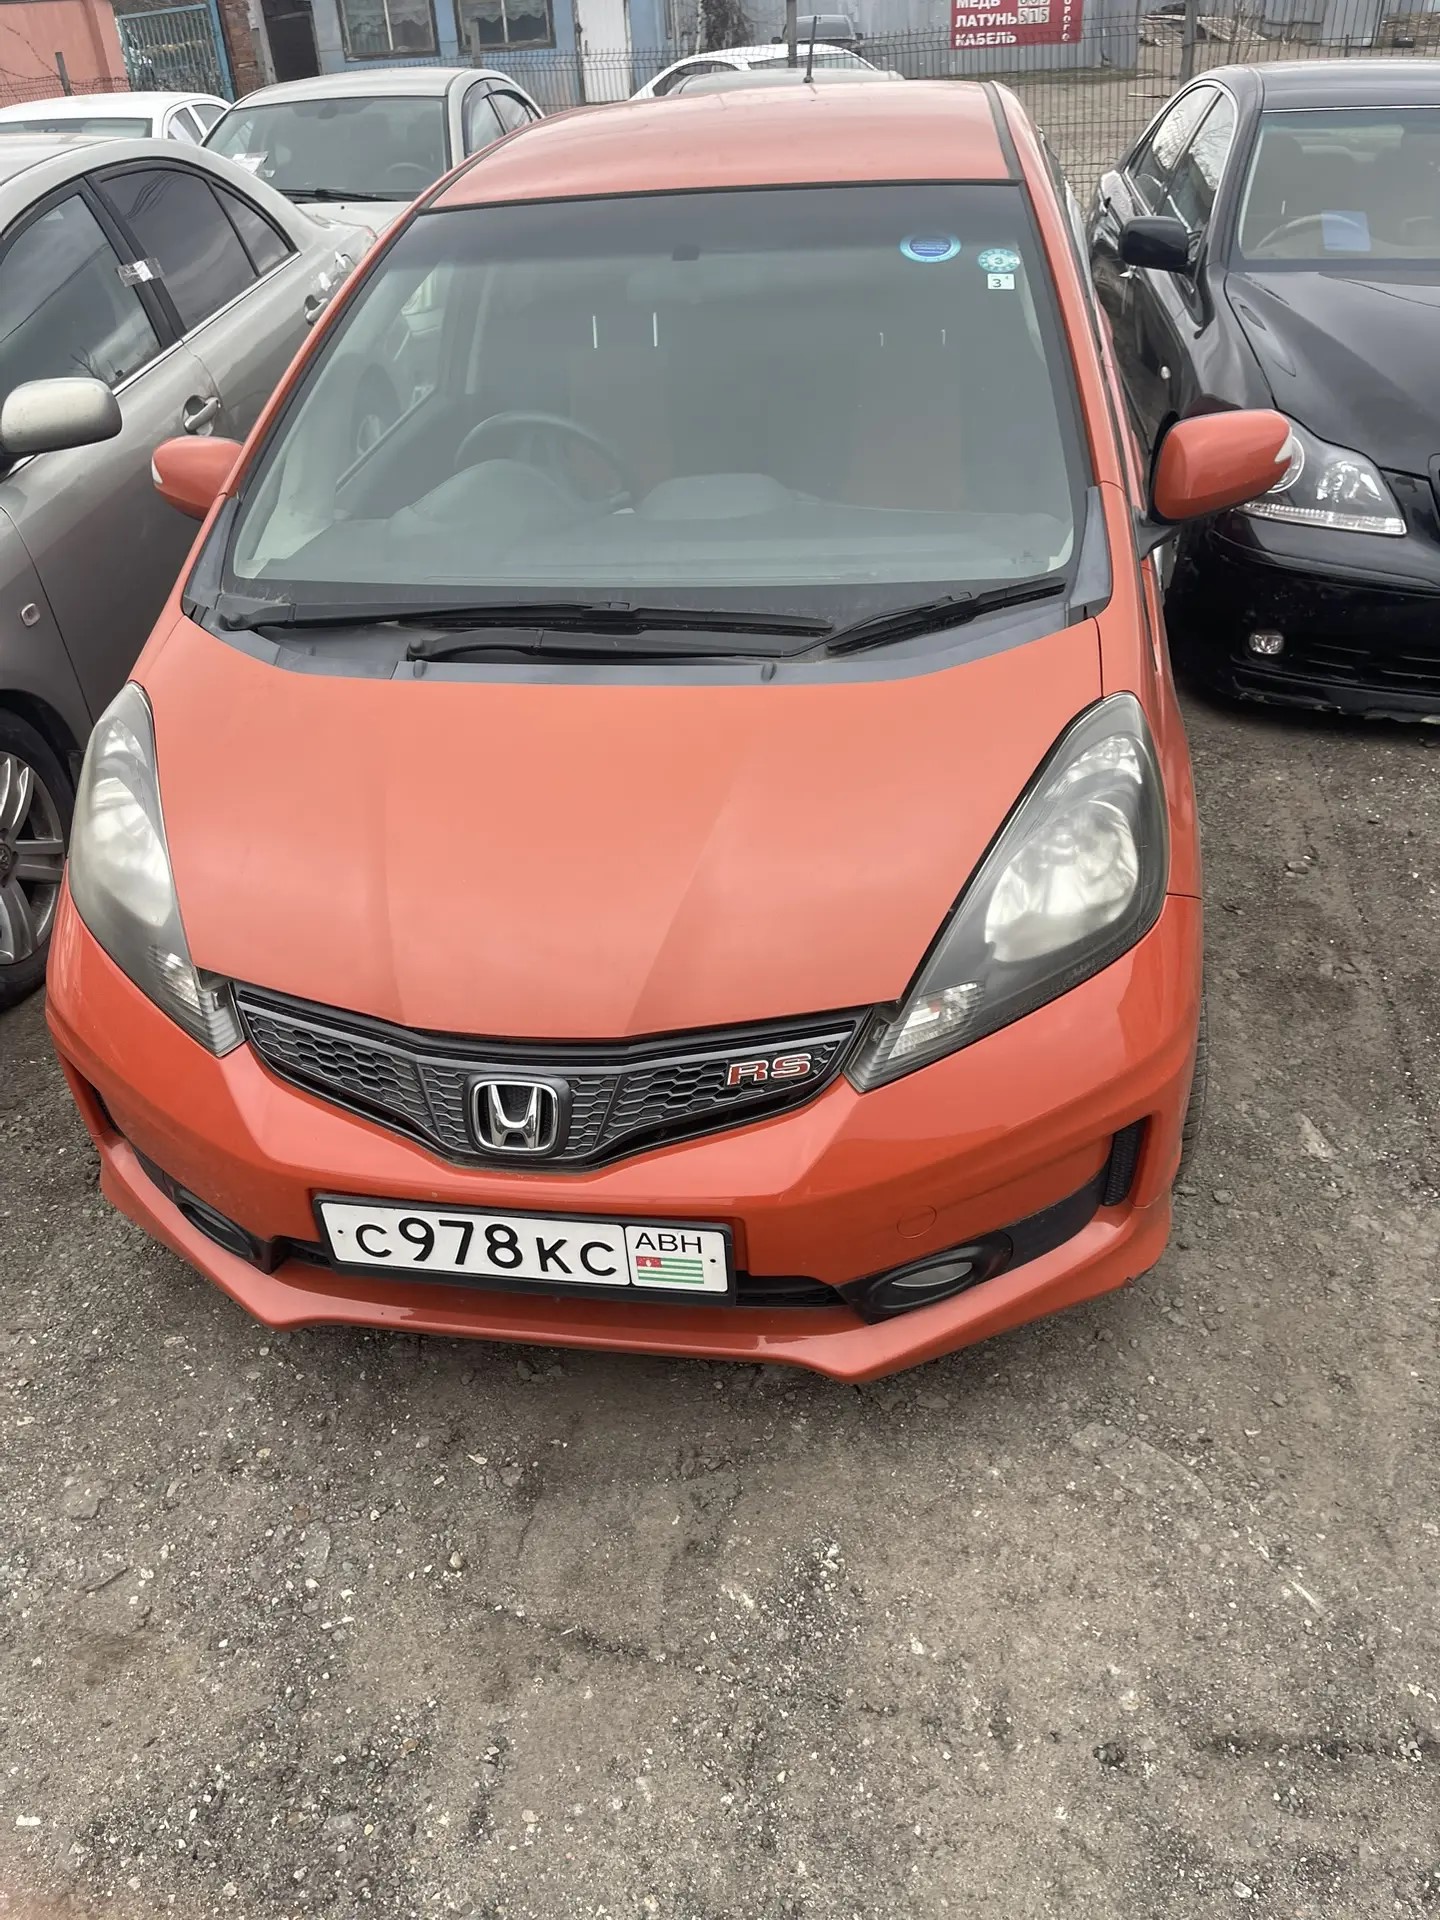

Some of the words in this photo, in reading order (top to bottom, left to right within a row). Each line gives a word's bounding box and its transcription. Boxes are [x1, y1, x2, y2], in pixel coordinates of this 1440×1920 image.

[955, 12, 1018, 28] ЛАТУНЬ
[1019, 8, 1048, 23] 515
[955, 32, 1017, 46] КАБЕЛЬ
[992, 278, 1002, 288] 3
[727, 1053, 812, 1087] RS
[634, 1231, 703, 1255] ABH
